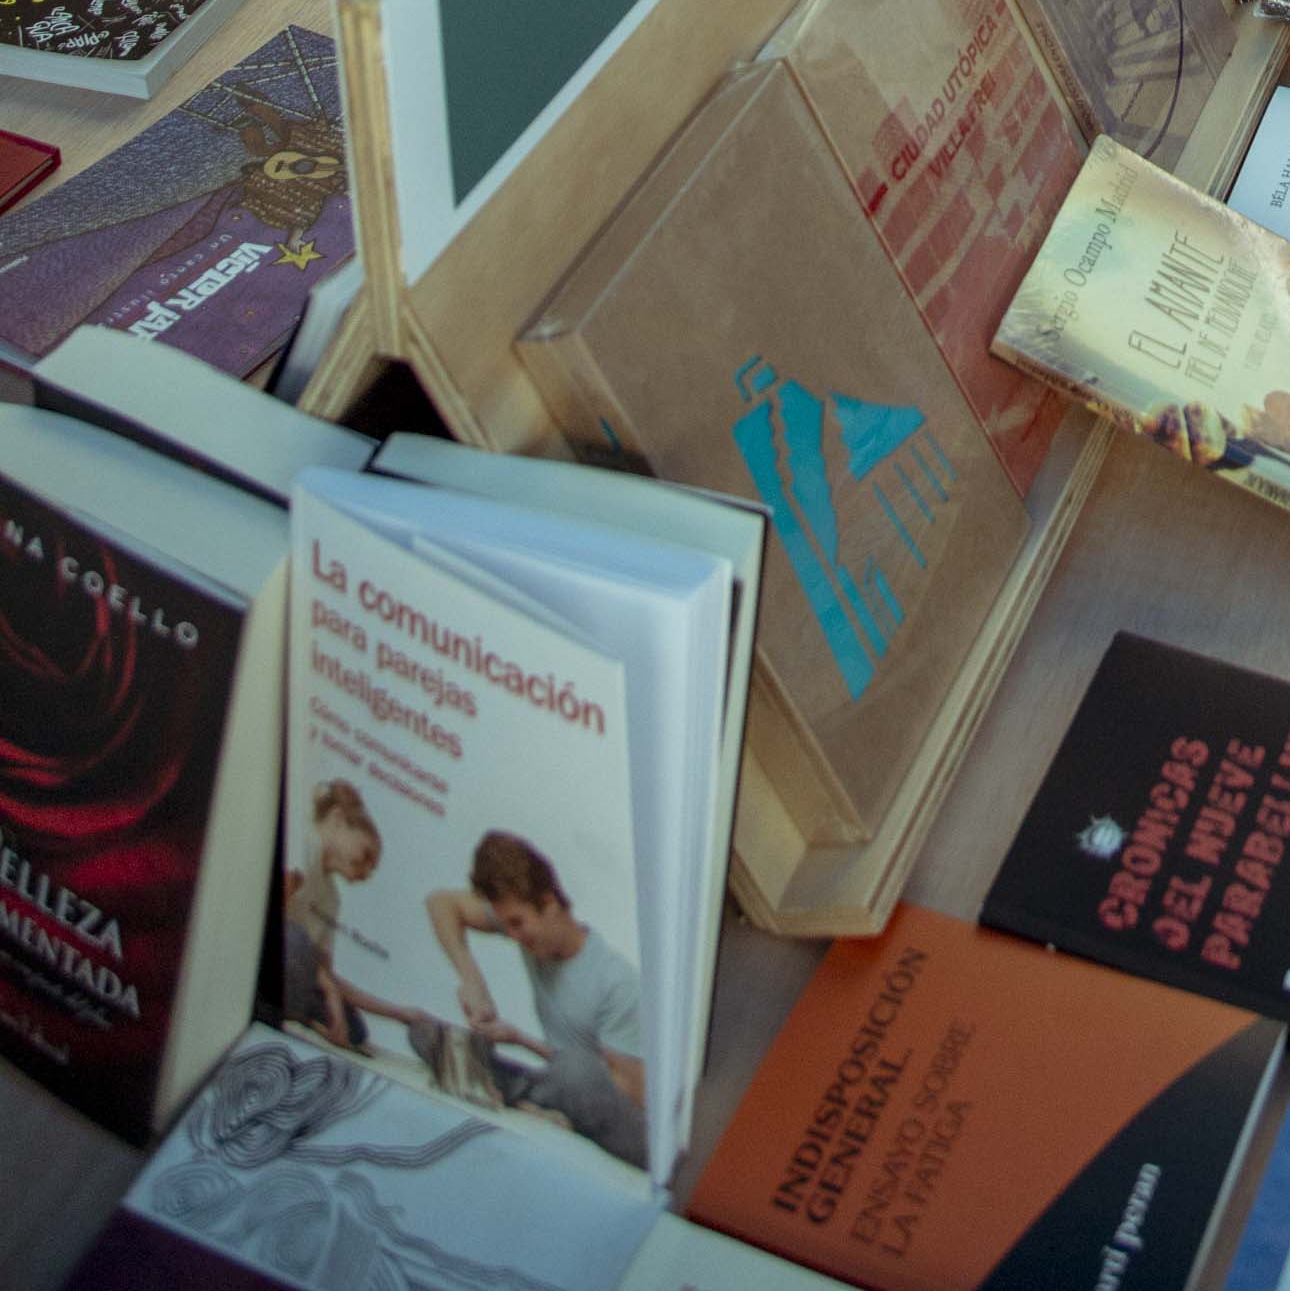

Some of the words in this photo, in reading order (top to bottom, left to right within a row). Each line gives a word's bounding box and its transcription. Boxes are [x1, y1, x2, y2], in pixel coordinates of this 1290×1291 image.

[891, 97, 945, 182] CIUDAD
[942, 14, 998, 104] UTÓPICA
[927, 118, 971, 179] VILLA
[1035, 288, 1080, 344] Sergio
[1063, 221, 1113, 288] Ocampo
[1094, 162, 1138, 224] Madrid
[1270, 179, 1290, 209] BÉLA
[1127, 329, 1188, 371] EL
[1144, 229, 1225, 333] AMANTE
[5, 519, 46, 564] NA
[60, 554, 201, 650] COELLO
[311, 539, 350, 590] La
[357, 566, 608, 736] comunicación
[310, 648, 466, 763] inteligentes
[311, 602, 368, 662] para
[375, 642, 480, 723] parejas
[0, 846, 123, 961] ELLEZA
[1097, 735, 1210, 930] CRONICAS
[1153, 870, 1204, 951] DEL
[1187, 737, 1267, 868] NUEVE
[773, 943, 929, 1214] INDISPOSICIÓN
[851, 1101, 926, 1247] ENSAYO
[916, 1013, 976, 1118] SOBRE
[883, 1201, 912, 1261] LA
[902, 1092, 976, 1206] FATIGA
